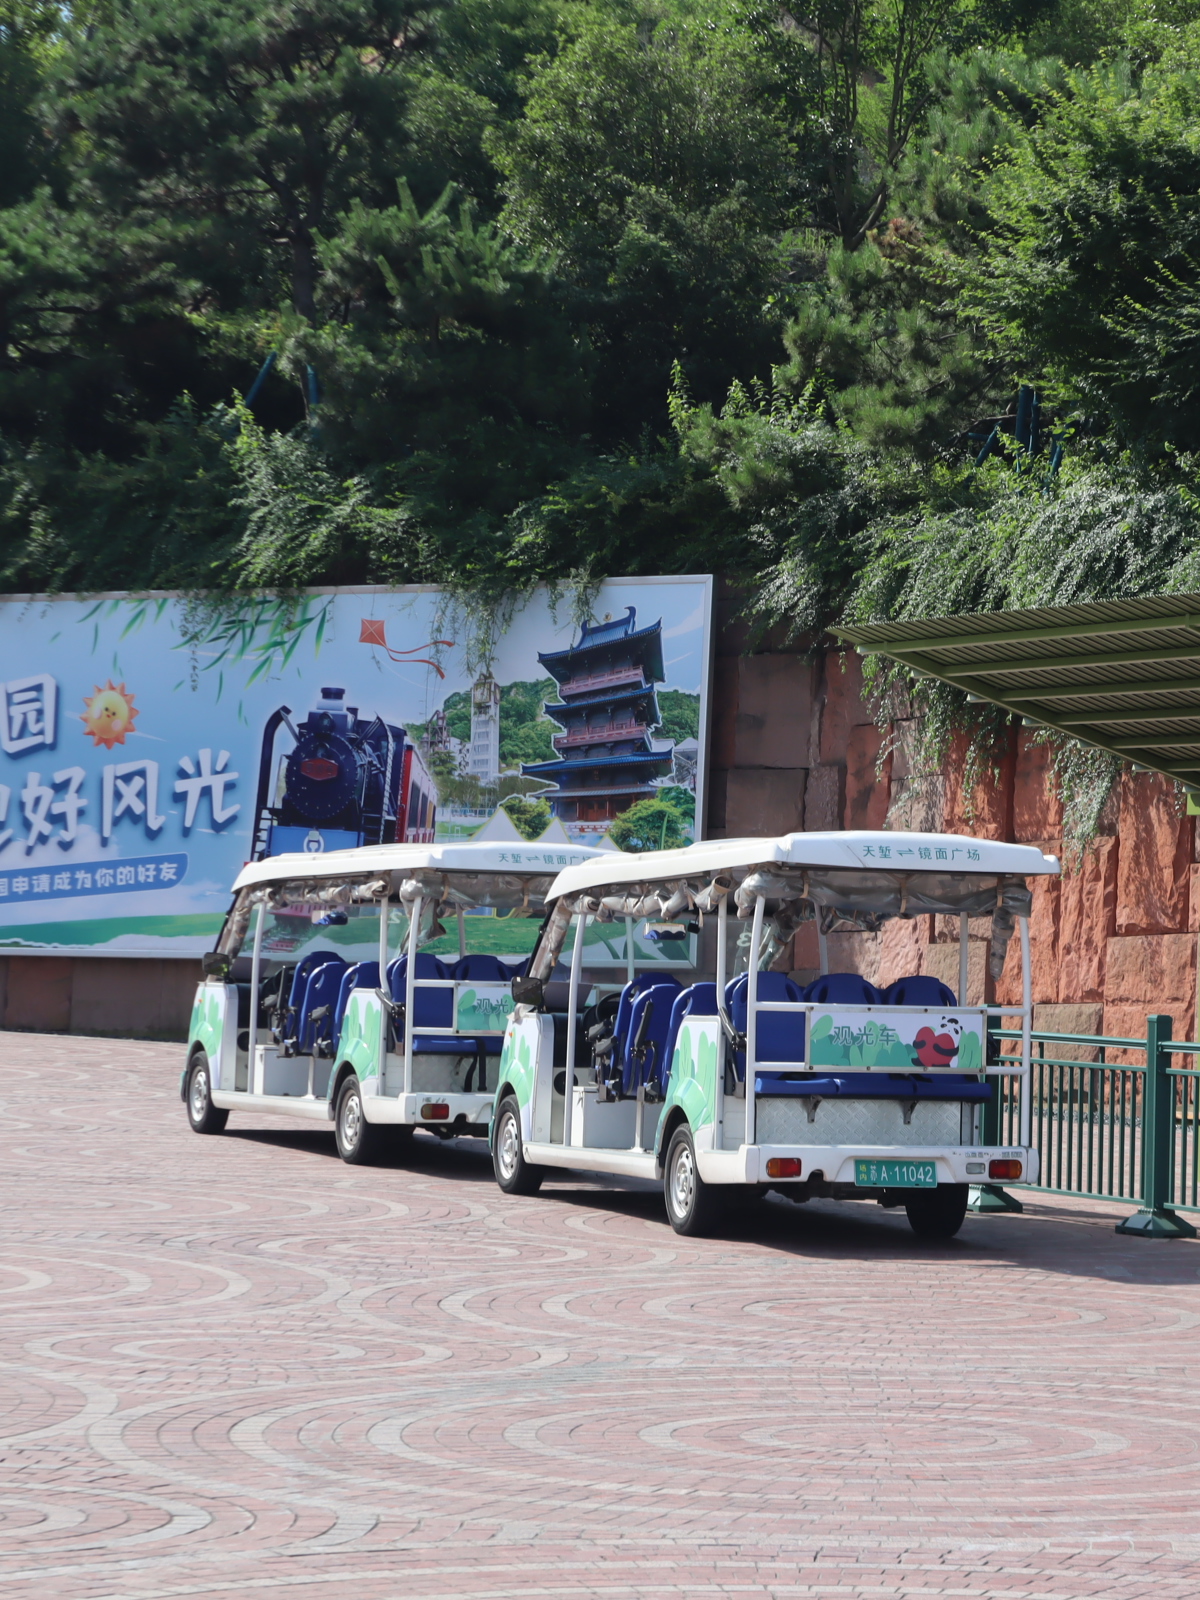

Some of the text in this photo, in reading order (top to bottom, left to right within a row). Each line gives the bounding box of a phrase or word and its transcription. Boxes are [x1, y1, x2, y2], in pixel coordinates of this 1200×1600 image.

[0, 673, 56, 754] 园
[863, 845, 980, 861] 天堑 镜面广场
[476, 999, 516, 1014] 观光
[833, 1025, 897, 1046] 观光车
